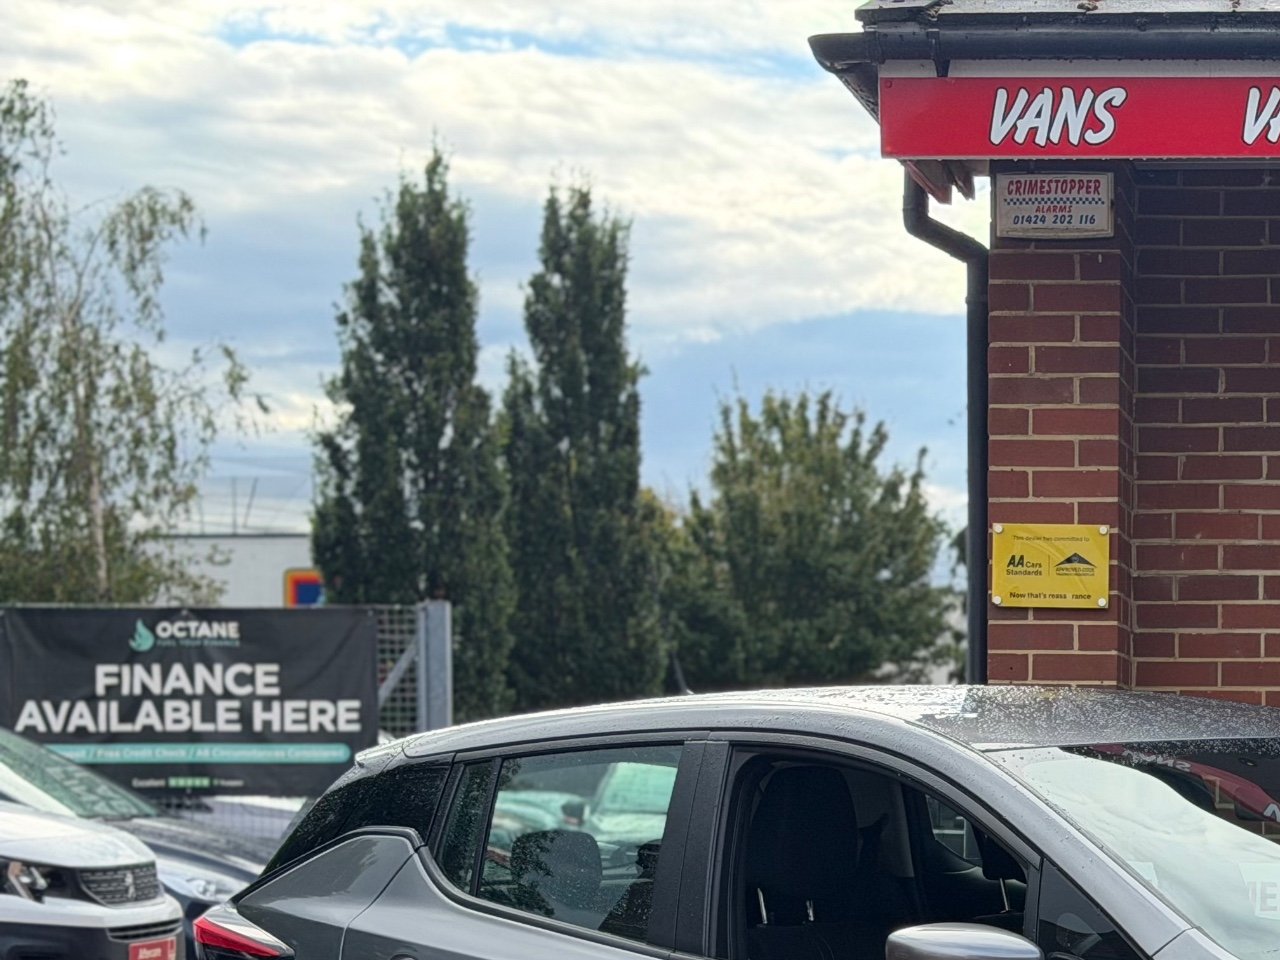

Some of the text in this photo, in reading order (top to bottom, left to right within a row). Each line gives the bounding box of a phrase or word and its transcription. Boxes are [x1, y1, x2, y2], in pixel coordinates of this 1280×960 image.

[989, 86, 1127, 148] VANS
[1007, 179, 1101, 196] CRIMESTOPPER
[1035, 205, 1073, 214] ALARMS
[1013, 215, 1096, 225] 01424 202 116
[1007, 554, 1042, 569] AA Cars
[155, 620, 241, 639] OCTANE
[95, 664, 280, 696] FINANCE
[15, 699, 361, 733] AVAILABLE HERE
